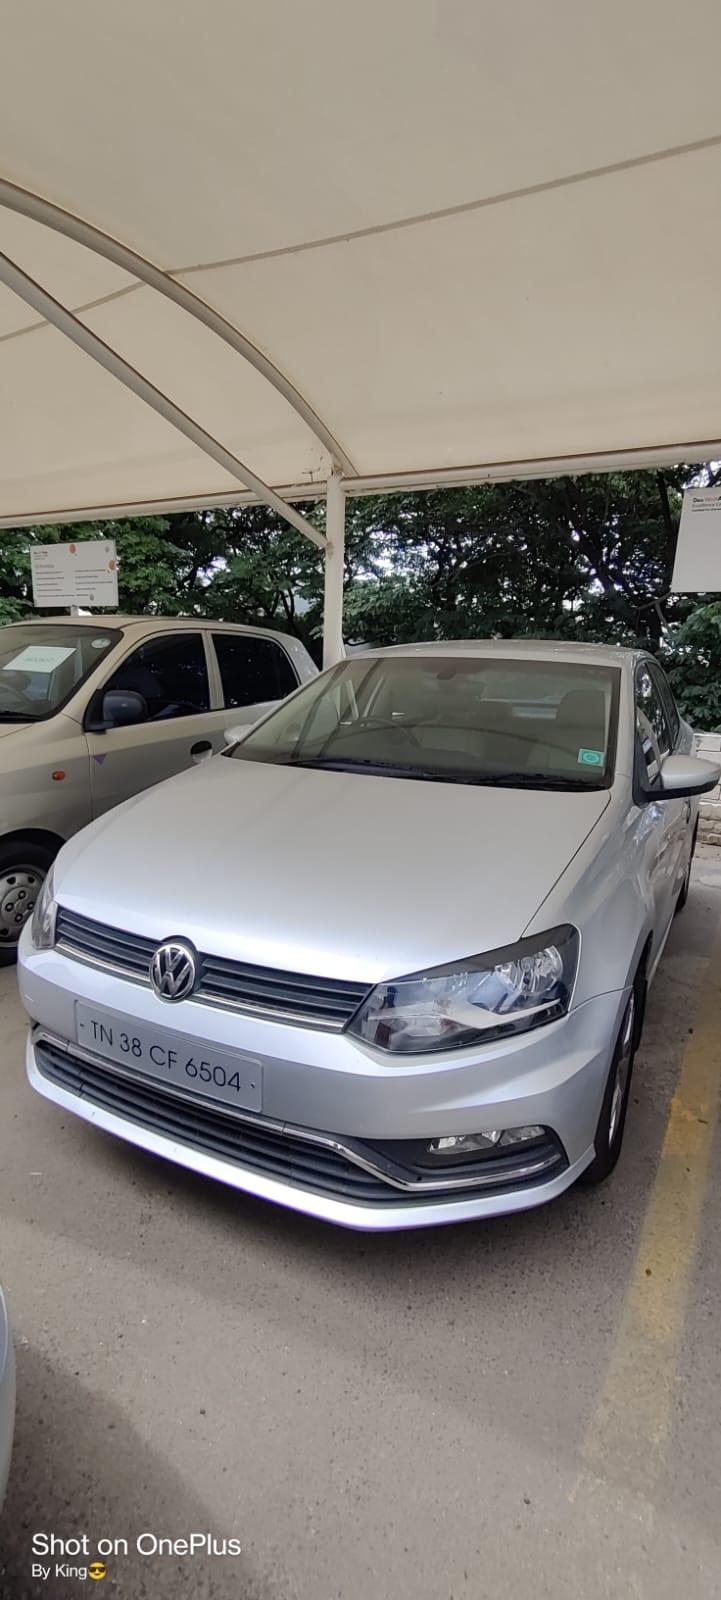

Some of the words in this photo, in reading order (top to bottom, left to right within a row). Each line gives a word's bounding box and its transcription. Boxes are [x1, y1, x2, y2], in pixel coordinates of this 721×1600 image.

[153, 946, 194, 999] VW
[91, 1020, 113, 1046] TN
[120, 1033, 142, 1057] 38
[150, 1045, 177, 1069] CF
[185, 1057, 241, 1092] 6504
